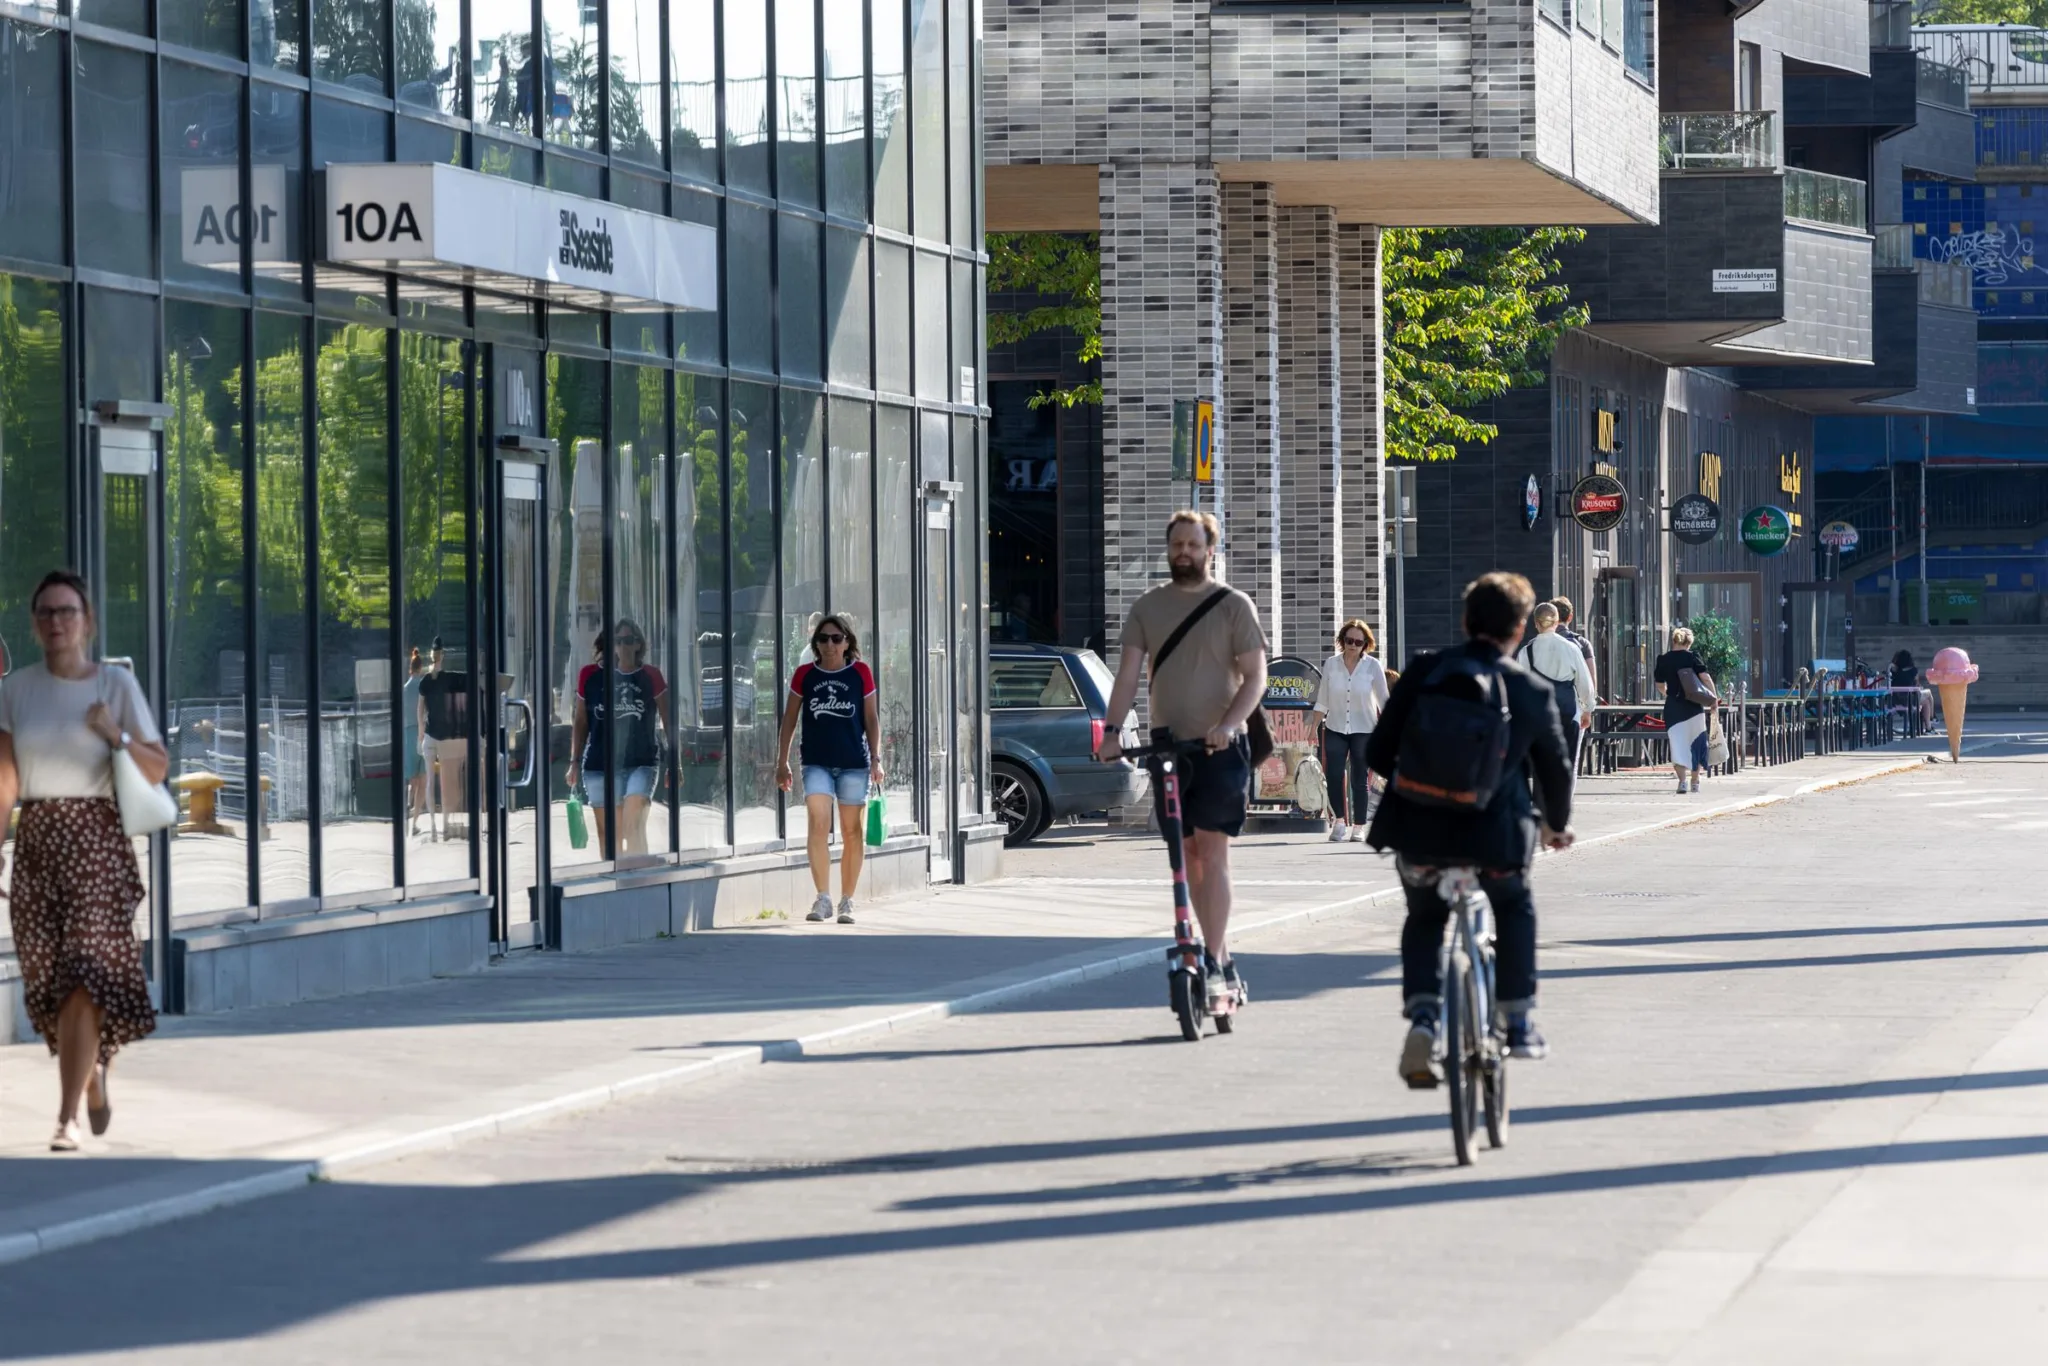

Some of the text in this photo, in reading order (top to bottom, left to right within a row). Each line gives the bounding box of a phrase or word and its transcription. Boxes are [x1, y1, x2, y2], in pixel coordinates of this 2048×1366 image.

[336, 202, 423, 242] 10A
[570, 211, 614, 275] Seaside
[1718, 271, 1775, 281] Fredriksdalsgatan
[1744, 532, 1786, 541] Heineken
[813, 680, 850, 693] PALM NIGHTS
[1270, 687, 1300, 697] BAR
[809, 696, 854, 716] Endless
